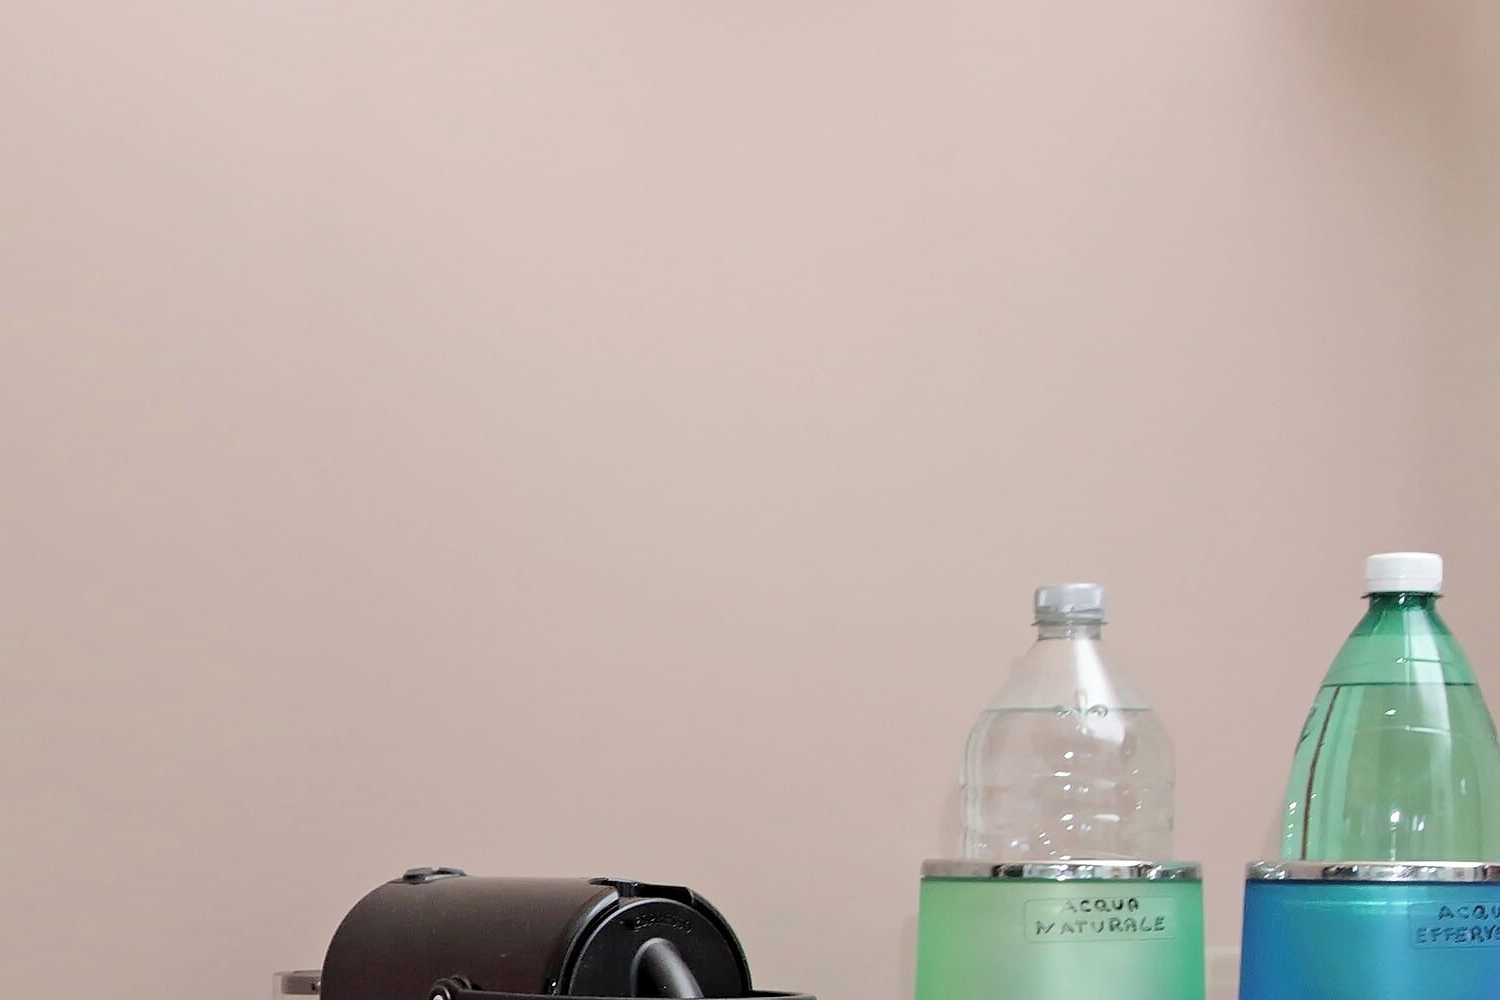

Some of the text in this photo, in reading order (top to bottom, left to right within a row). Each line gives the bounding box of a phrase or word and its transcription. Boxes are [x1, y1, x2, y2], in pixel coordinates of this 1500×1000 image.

[1060, 897, 1141, 914] ACQUA
[1437, 903, 1500, 920] ACQU
[1035, 915, 1166, 935] NATURALE
